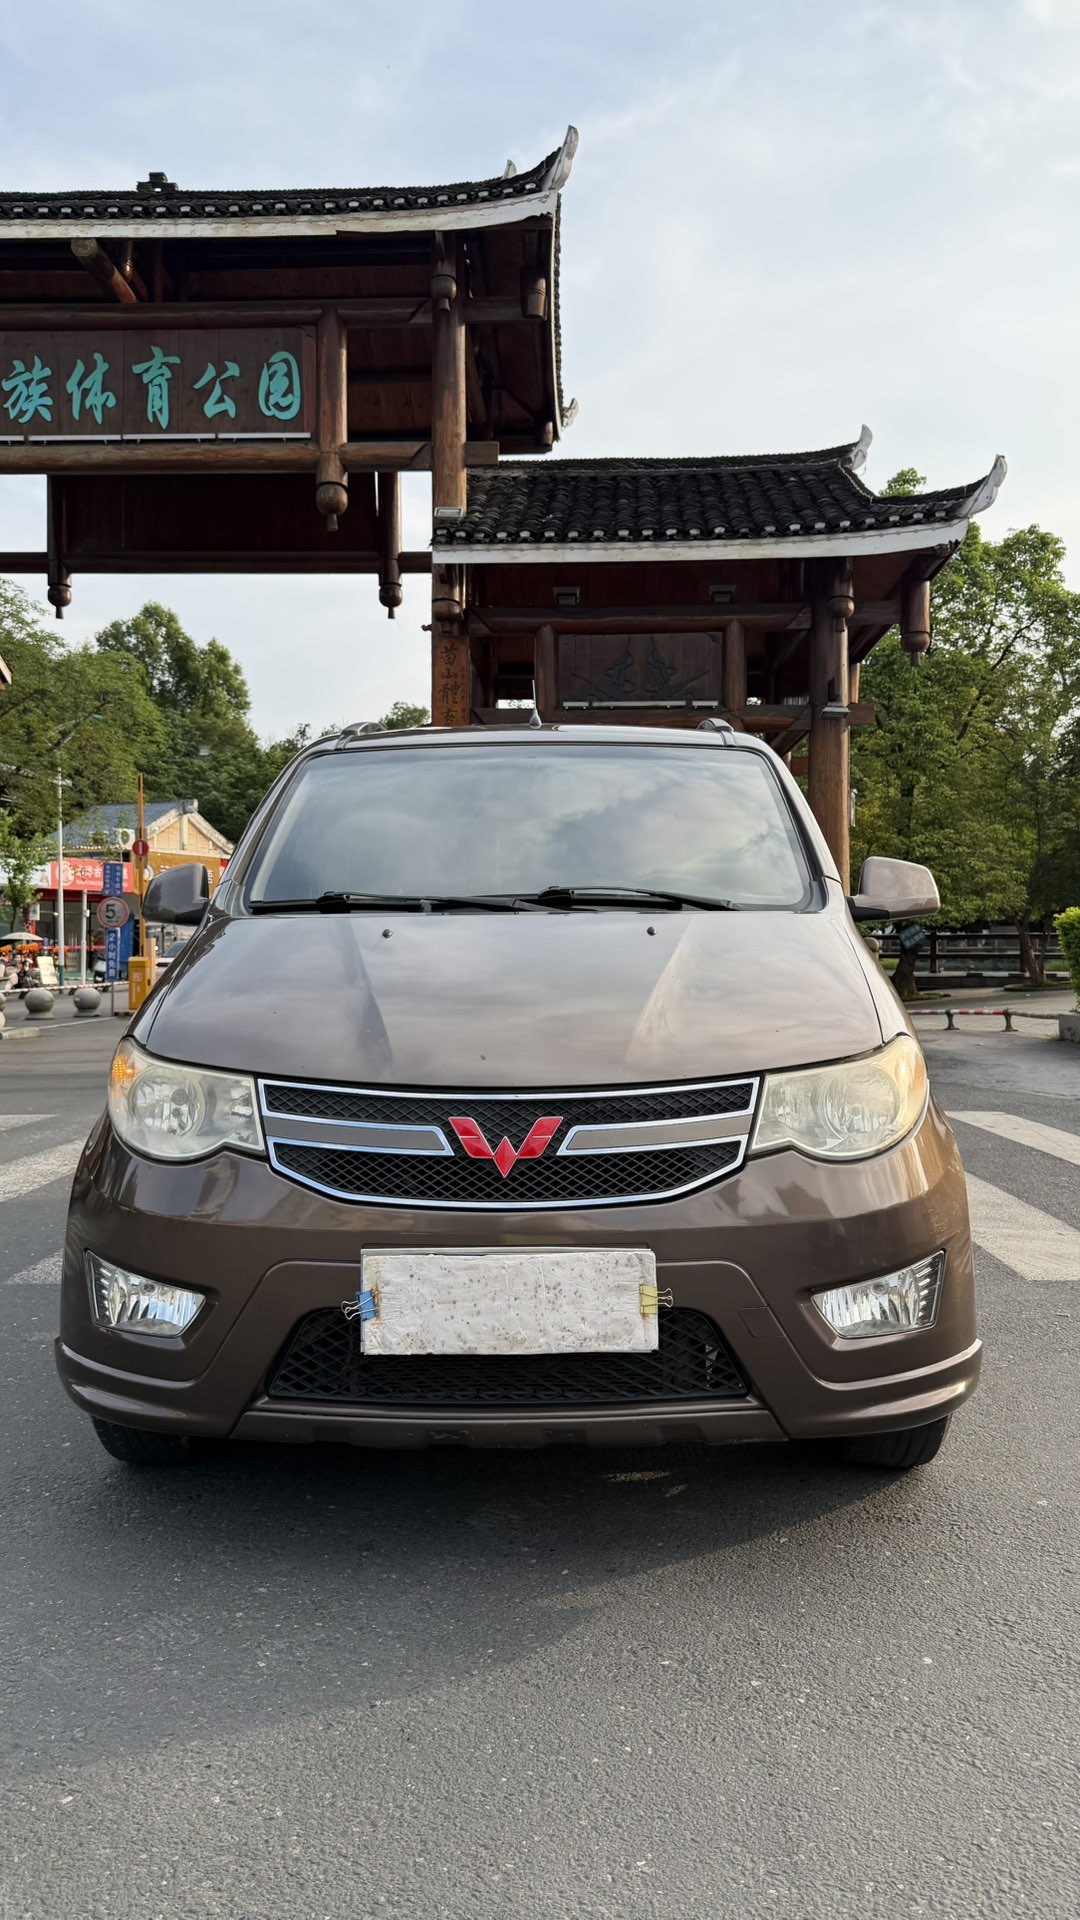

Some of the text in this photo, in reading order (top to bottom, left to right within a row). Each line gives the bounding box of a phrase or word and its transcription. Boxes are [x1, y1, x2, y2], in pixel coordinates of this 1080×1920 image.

[2, 346, 301, 430] 族体育公园
[105, 904, 116, 919] 5
